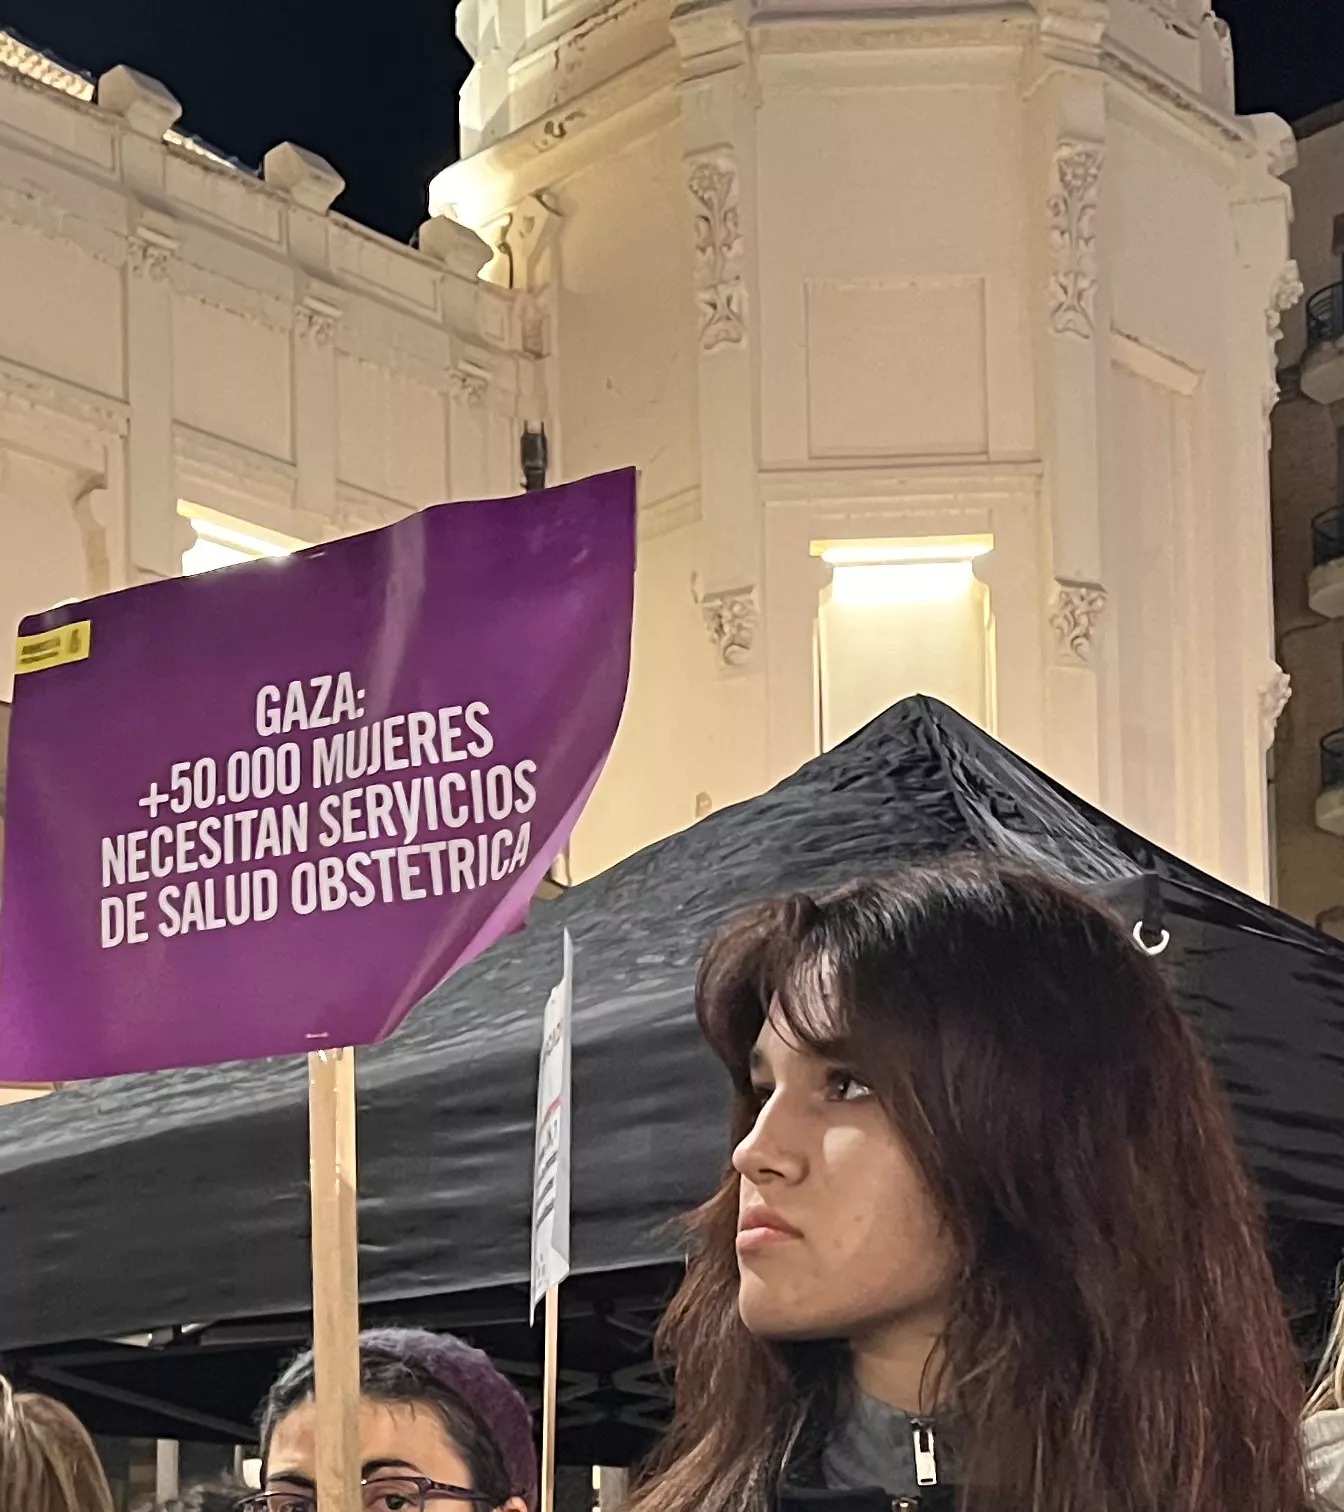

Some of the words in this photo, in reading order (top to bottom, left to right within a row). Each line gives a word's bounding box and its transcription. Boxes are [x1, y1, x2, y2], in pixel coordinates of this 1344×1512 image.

[256, 672, 365, 737] GAZA:
[139, 742, 300, 818] +50.000
[313, 702, 493, 789] MUJERES
[101, 802, 308, 887] NECESITAN
[318, 760, 537, 847] SERVICIOS
[101, 893, 148, 949] DE
[158, 870, 278, 938] SALUD
